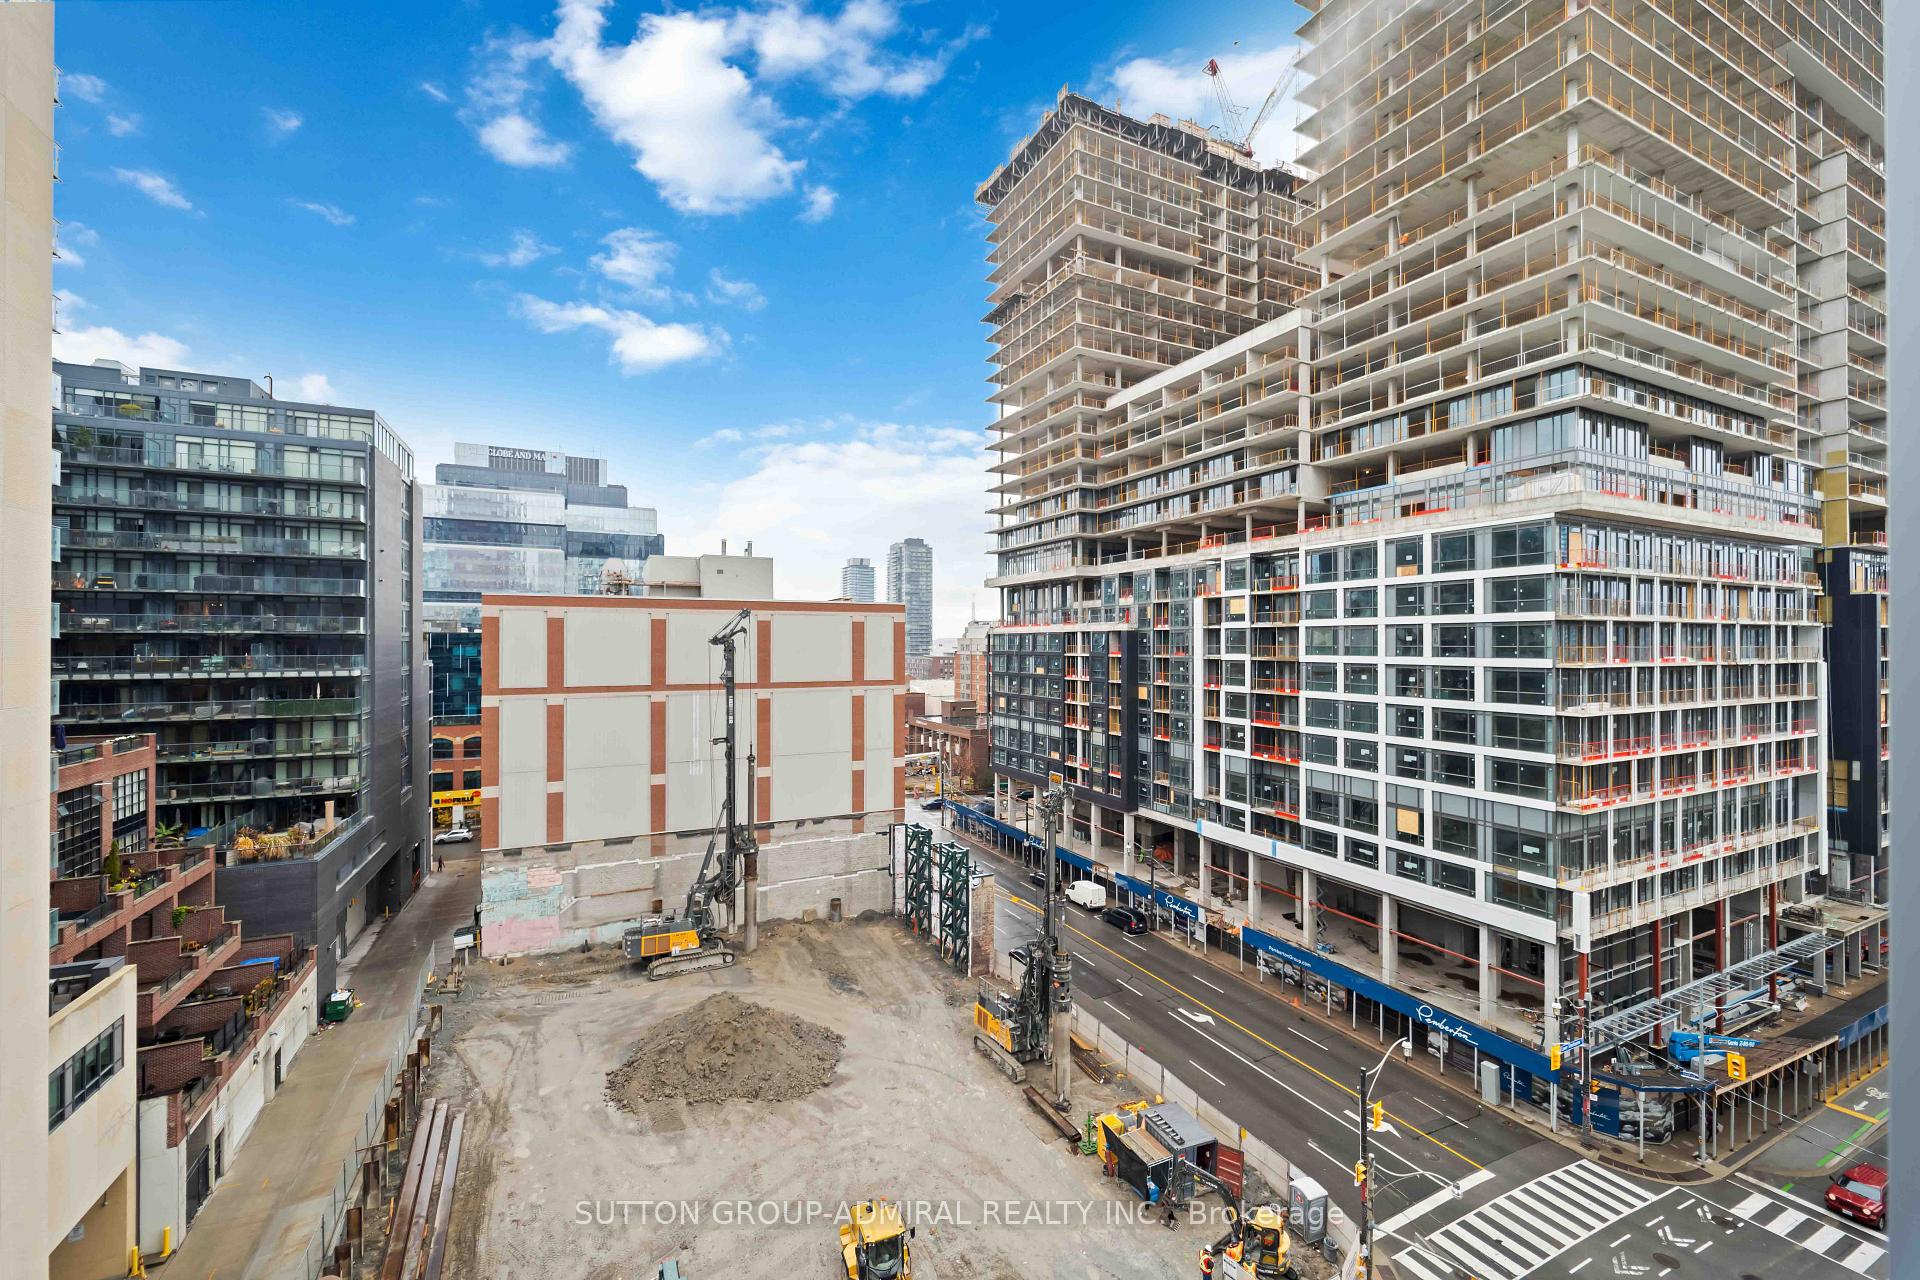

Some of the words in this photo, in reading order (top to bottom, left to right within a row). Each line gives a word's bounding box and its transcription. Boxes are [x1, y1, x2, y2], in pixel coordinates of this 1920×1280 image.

[488, 448, 513, 458] GLOBE
[514, 451, 531, 460] AND
[1416, 1005, 1479, 1046] Pemberton
